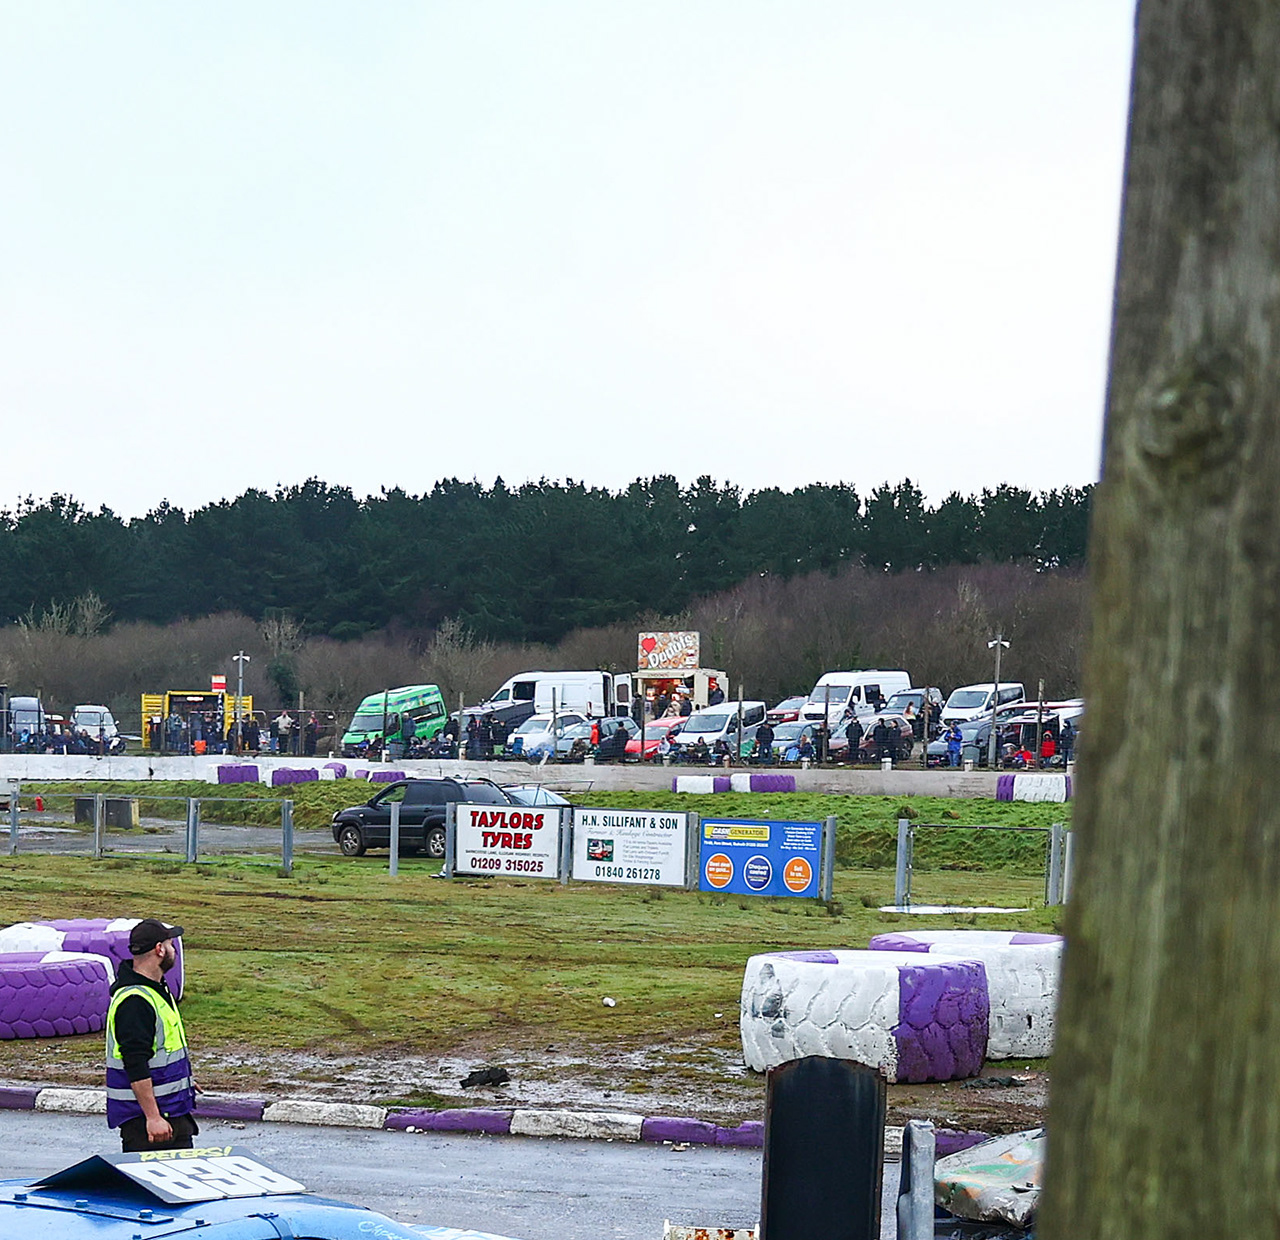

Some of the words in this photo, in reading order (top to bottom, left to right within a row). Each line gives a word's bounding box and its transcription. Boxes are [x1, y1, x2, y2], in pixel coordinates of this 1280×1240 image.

[470, 811, 544, 830] TAYLORS
[582, 815, 600, 826] H.N.
[602, 815, 647, 828] SILLIFANT
[650, 818, 656, 829] &
[660, 818, 678, 829] SON
[482, 832, 533, 849] TYRES
[470, 857, 501, 870] 01209
[505, 859, 544, 873] 315025
[595, 866, 623, 878] 01840
[626, 868, 661, 880] 261278
[138, 1146, 233, 1162] PETERS!
[115, 1155, 307, 1201] 838
